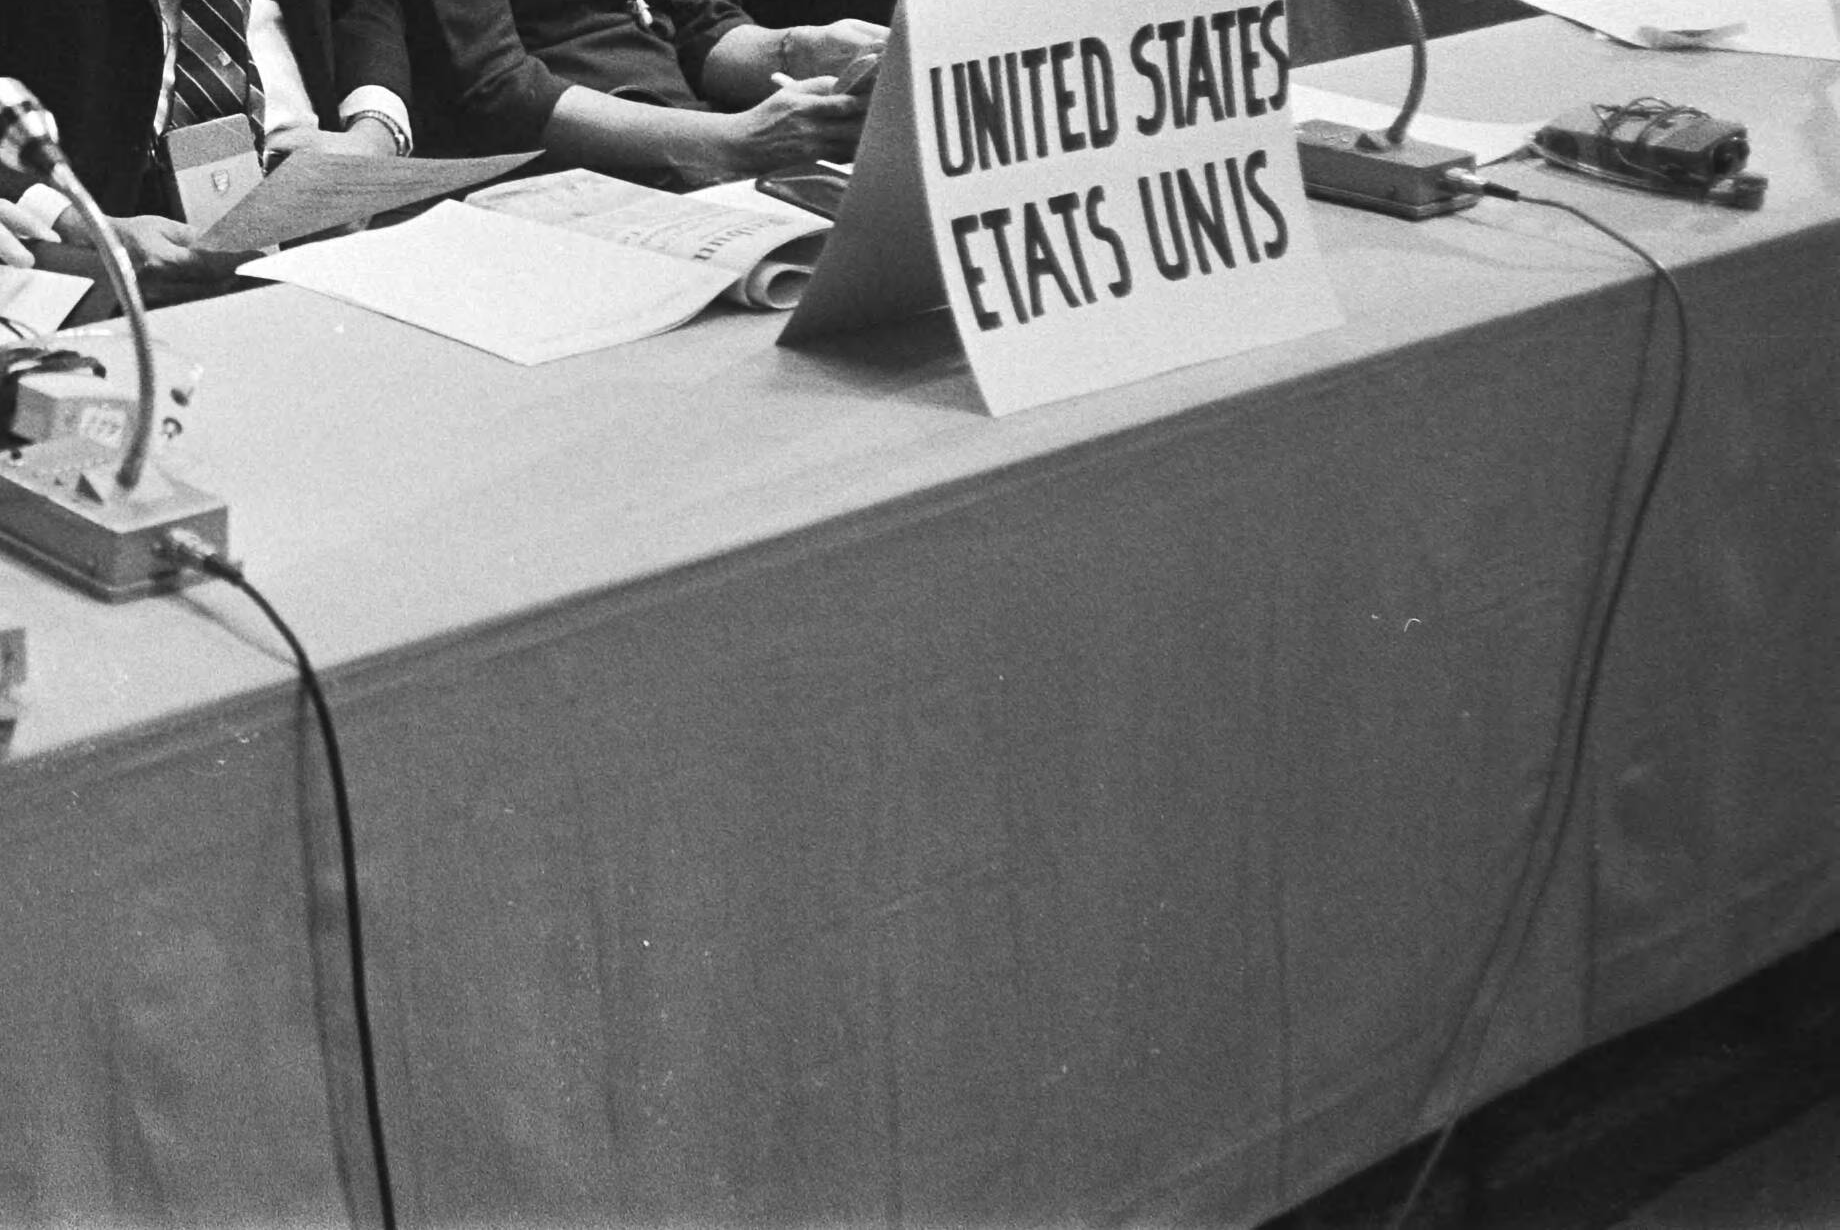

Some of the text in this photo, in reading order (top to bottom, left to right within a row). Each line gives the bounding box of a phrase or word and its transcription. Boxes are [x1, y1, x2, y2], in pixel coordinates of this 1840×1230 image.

[929, 0, 1290, 178] UNITED STATES
[950, 149, 1290, 332] ETATS UNIS
